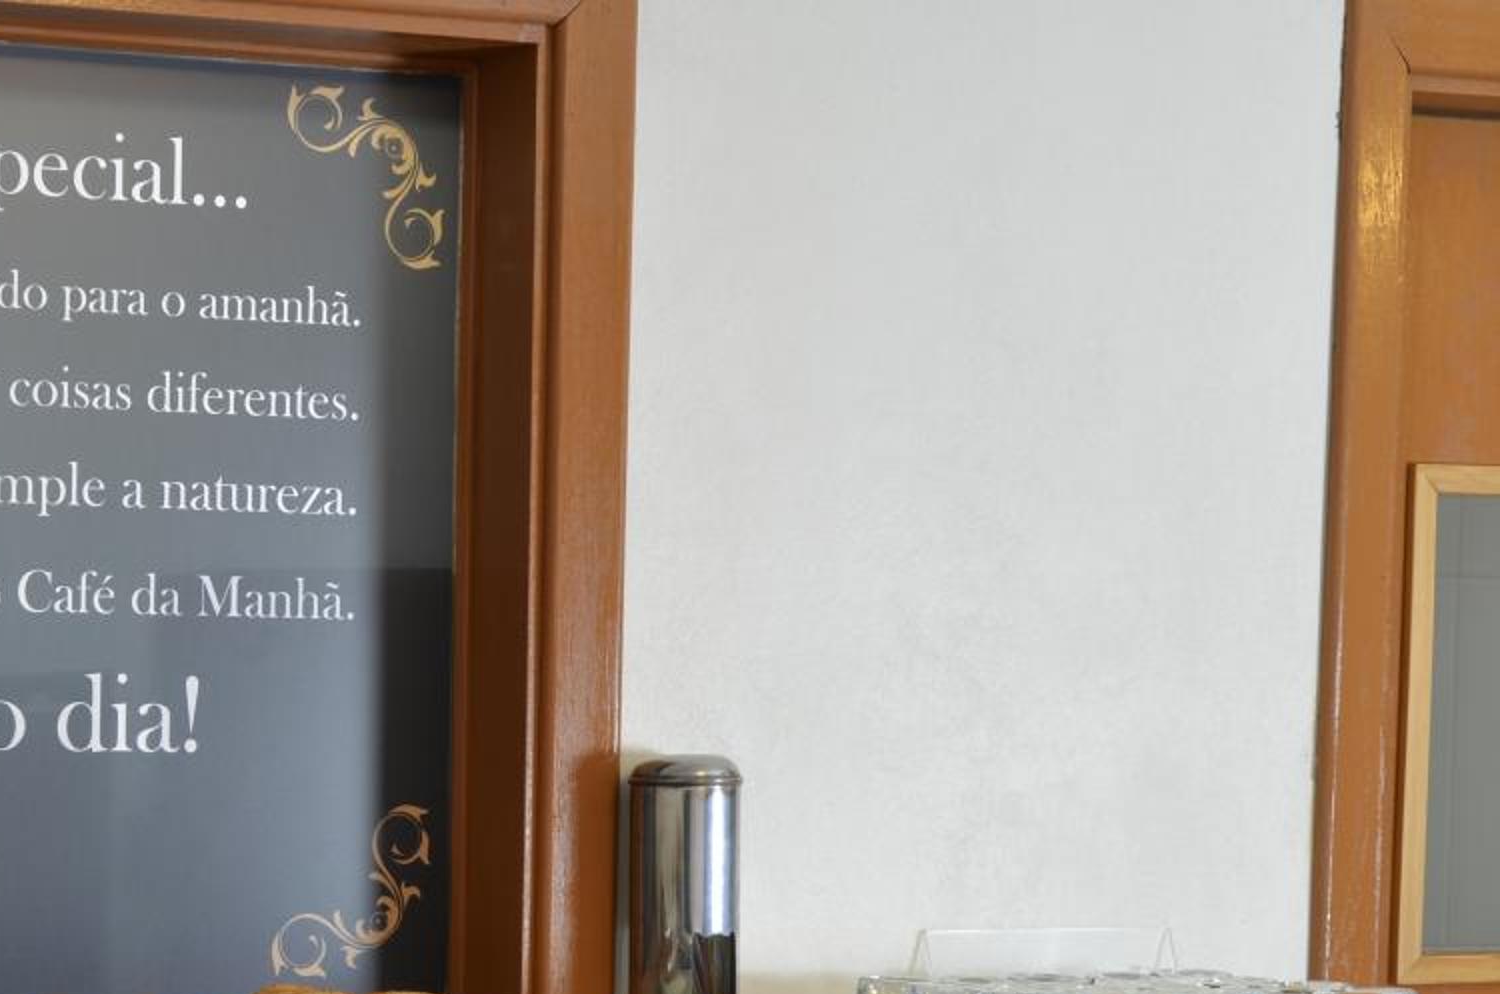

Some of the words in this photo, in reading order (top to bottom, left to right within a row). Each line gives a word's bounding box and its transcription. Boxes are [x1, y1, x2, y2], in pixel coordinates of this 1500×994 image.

[61, 285, 149, 323] para
[160, 291, 187, 318] o
[198, 284, 362, 328] amanhã.
[8, 364, 133, 411] coisas
[146, 369, 360, 422] diferentes.
[121, 479, 147, 510] a
[159, 475, 357, 517] natureza.
[17, 568, 116, 616] Café
[130, 572, 183, 617] da
[197, 574, 355, 621] Manhã.
[56, 671, 200, 754] dia!
